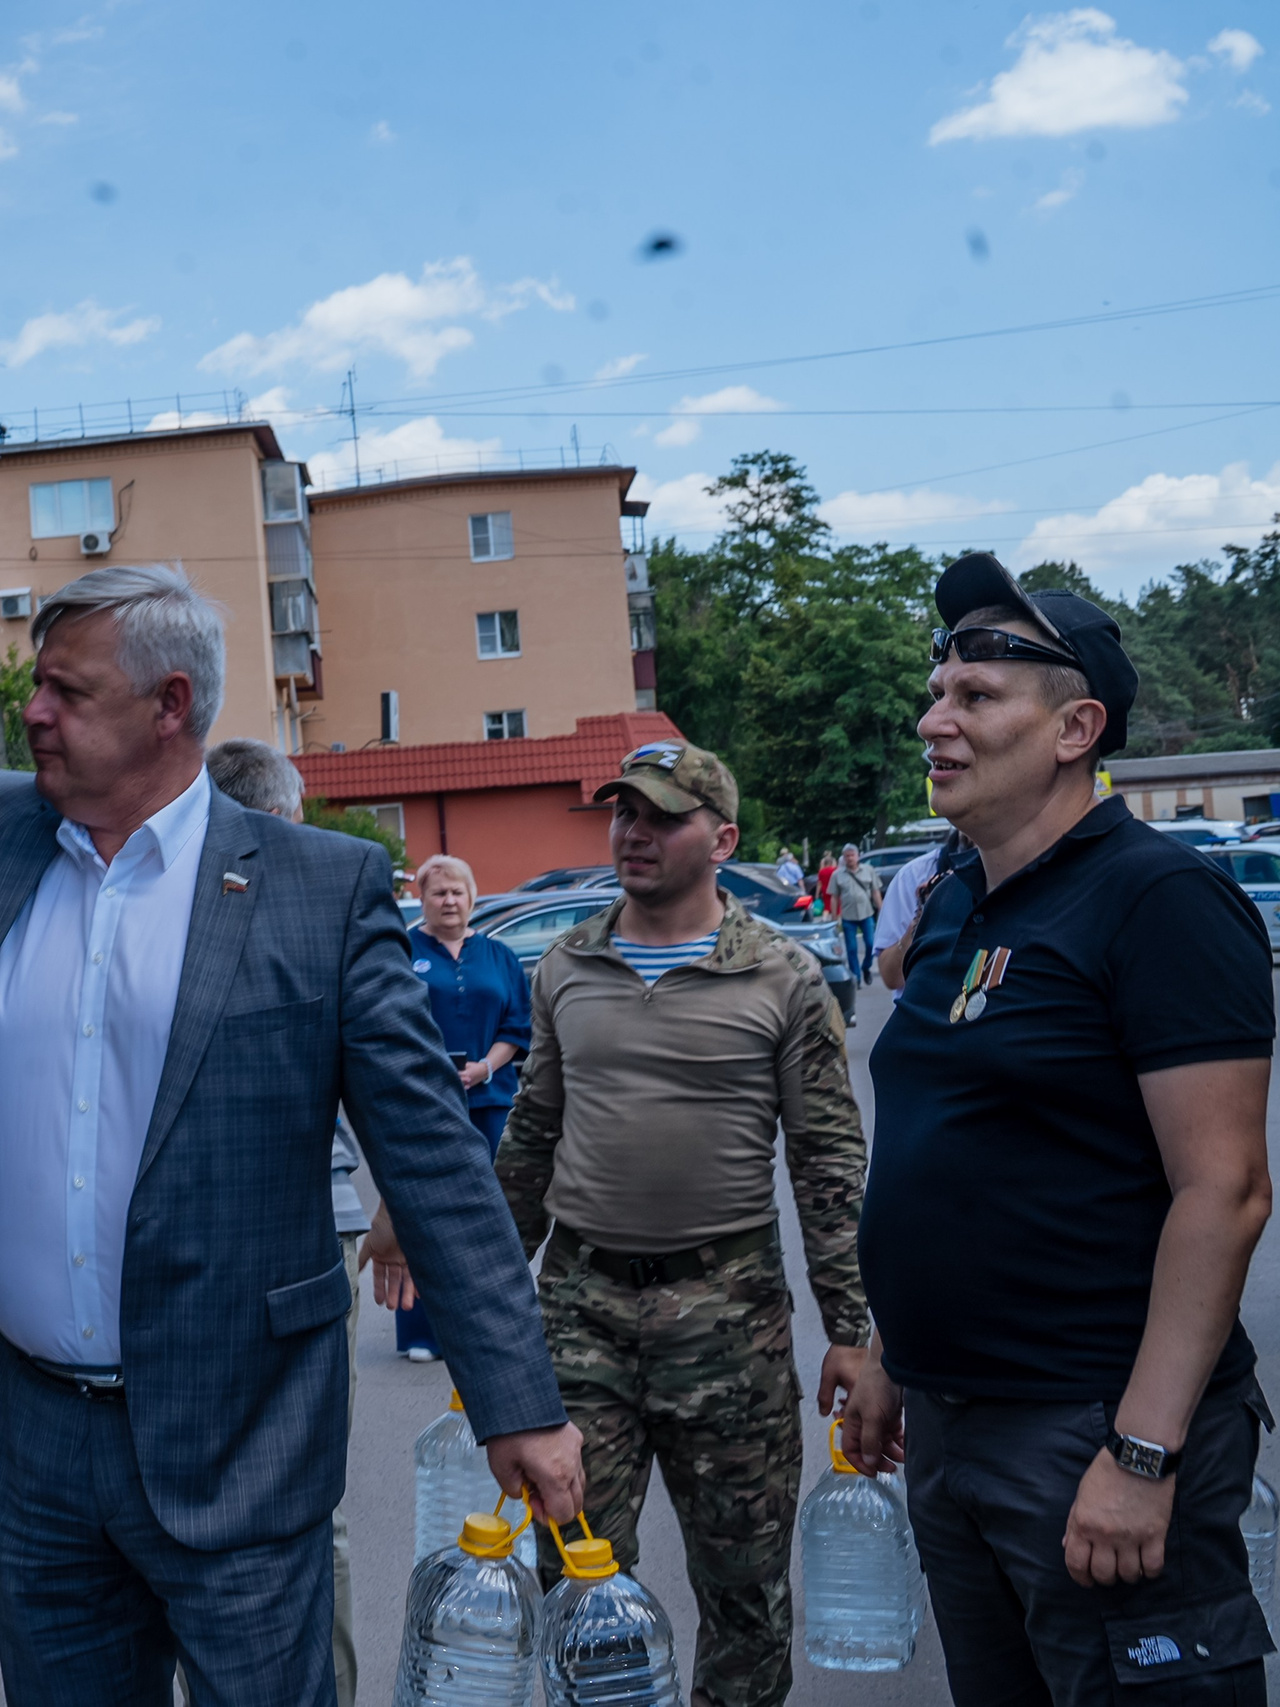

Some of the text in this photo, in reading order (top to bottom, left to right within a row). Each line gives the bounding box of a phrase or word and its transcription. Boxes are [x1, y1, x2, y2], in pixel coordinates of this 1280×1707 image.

[1138, 1637, 1158, 1648] THE
[1127, 1646, 1160, 1660] NORTH
[1137, 1656, 1162, 1667] FACE
